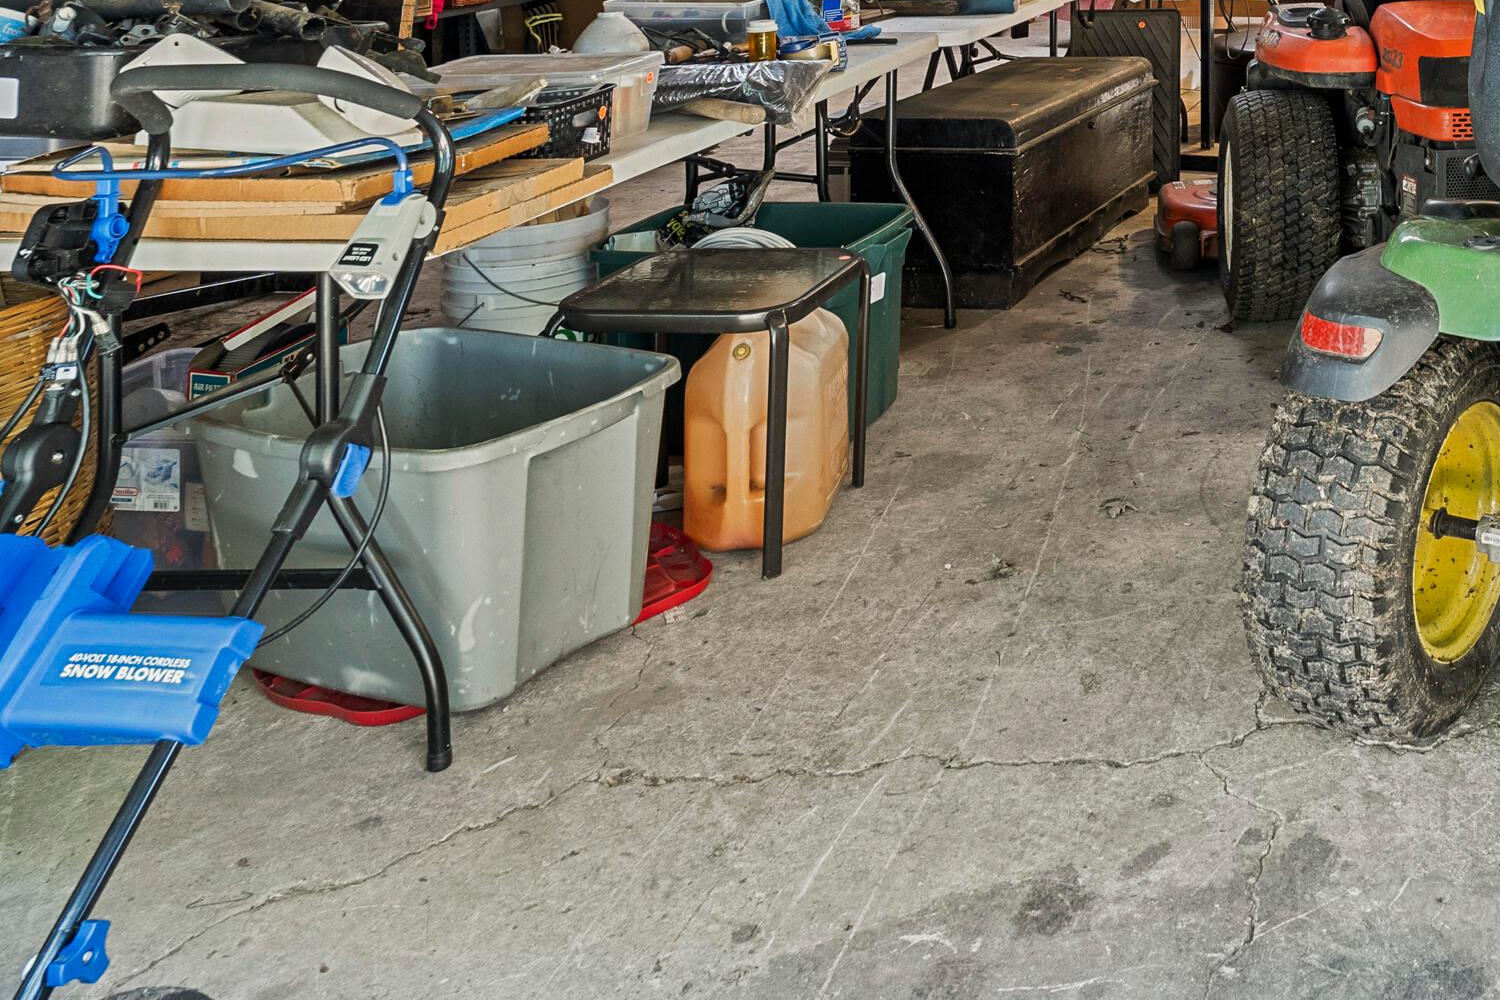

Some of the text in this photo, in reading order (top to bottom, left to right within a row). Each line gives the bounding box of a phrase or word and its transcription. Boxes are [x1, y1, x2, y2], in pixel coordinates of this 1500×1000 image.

[193, 382, 205, 391] AIR
[68, 652, 192, 669] 40-VOLT 18-INCH CORDLESS
[59, 663, 186, 684] SNOW BLOWER
